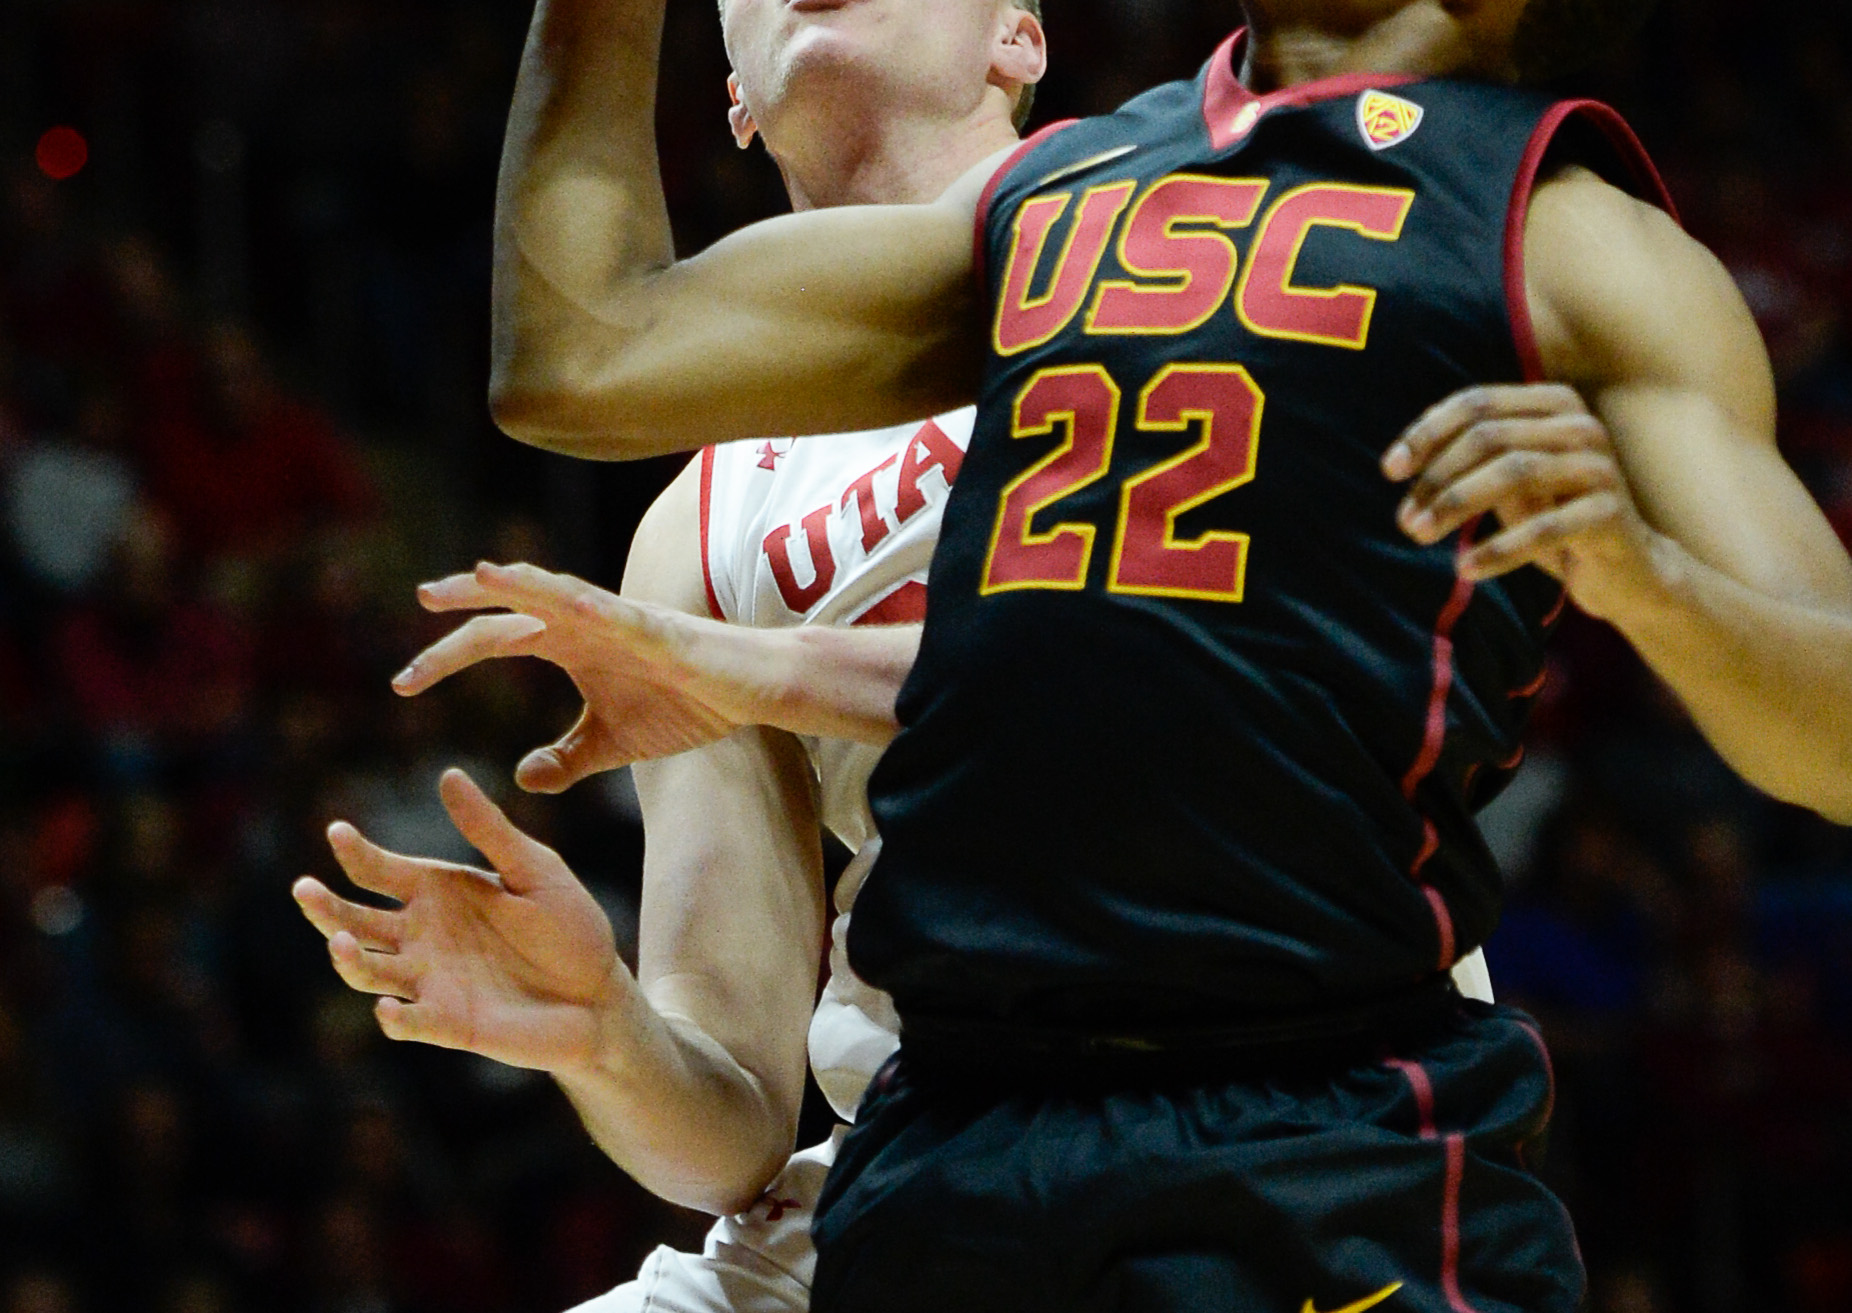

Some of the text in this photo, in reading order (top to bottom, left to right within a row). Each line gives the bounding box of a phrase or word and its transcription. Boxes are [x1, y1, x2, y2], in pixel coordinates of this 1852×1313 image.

[993, 173, 1415, 356] USC
[762, 418, 967, 614] UTA
[979, 363, 1265, 603] 22
